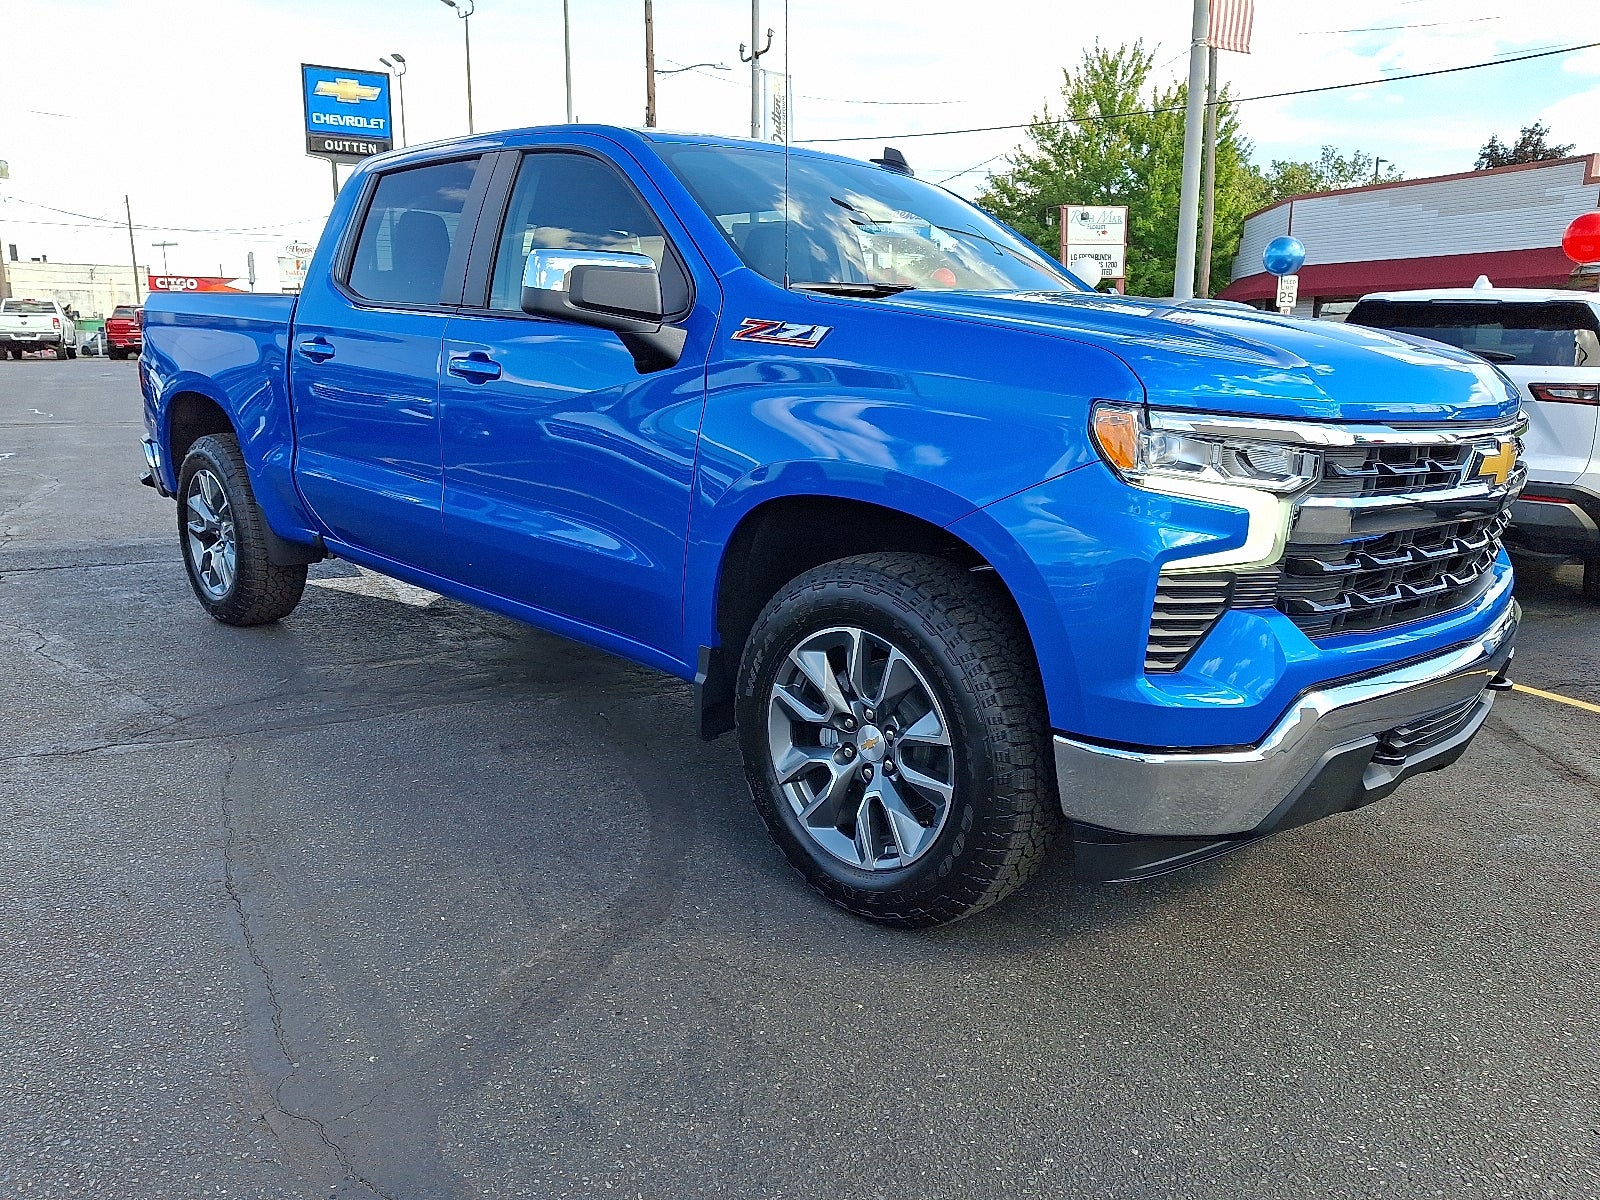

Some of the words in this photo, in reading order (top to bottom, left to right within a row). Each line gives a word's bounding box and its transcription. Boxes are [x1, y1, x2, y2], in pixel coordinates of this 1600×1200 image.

[312, 112, 385, 129] CHEVROLET
[324, 140, 377, 153] OUTTEN
[1070, 253, 1078, 261] LG
[155, 277, 198, 290] CITGO
[1279, 291, 1294, 304] 25
[730, 317, 835, 350] Z71
